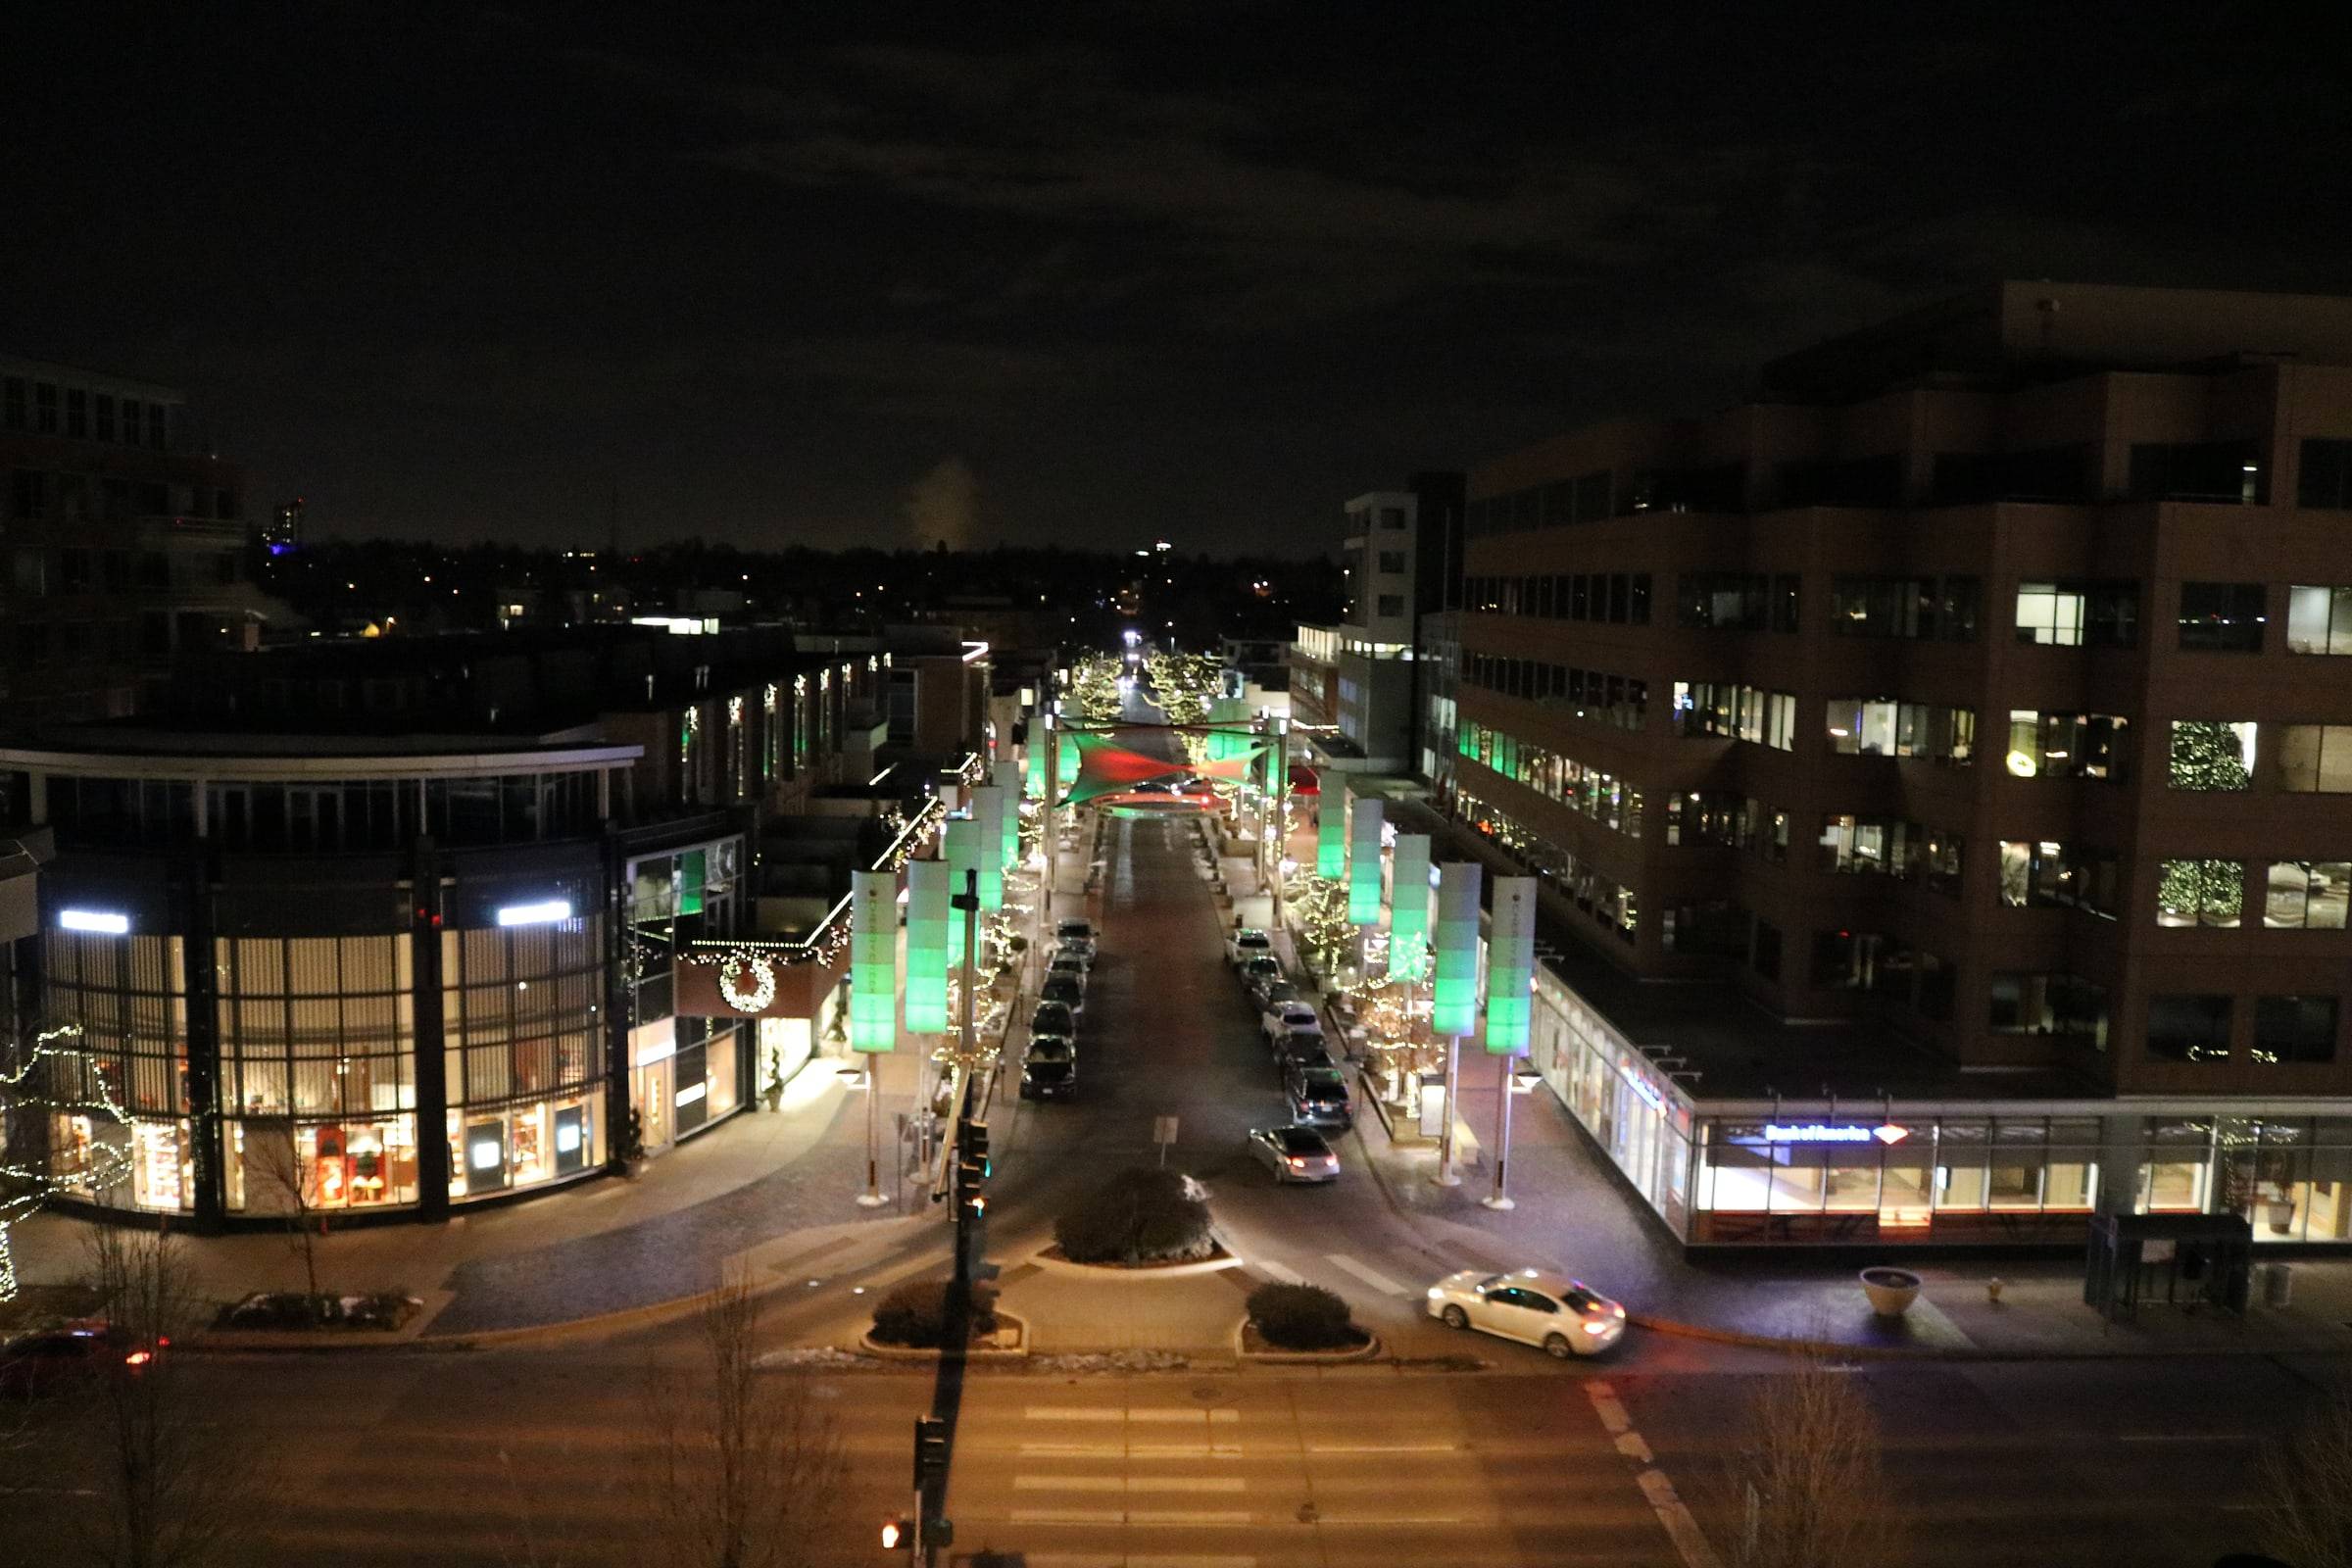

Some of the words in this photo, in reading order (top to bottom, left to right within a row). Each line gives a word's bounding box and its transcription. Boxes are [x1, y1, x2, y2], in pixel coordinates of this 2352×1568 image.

[1765, 1124, 1800, 1141] Bank
[1801, 1124, 1816, 1141] of
[1816, 1124, 1871, 1141] America
